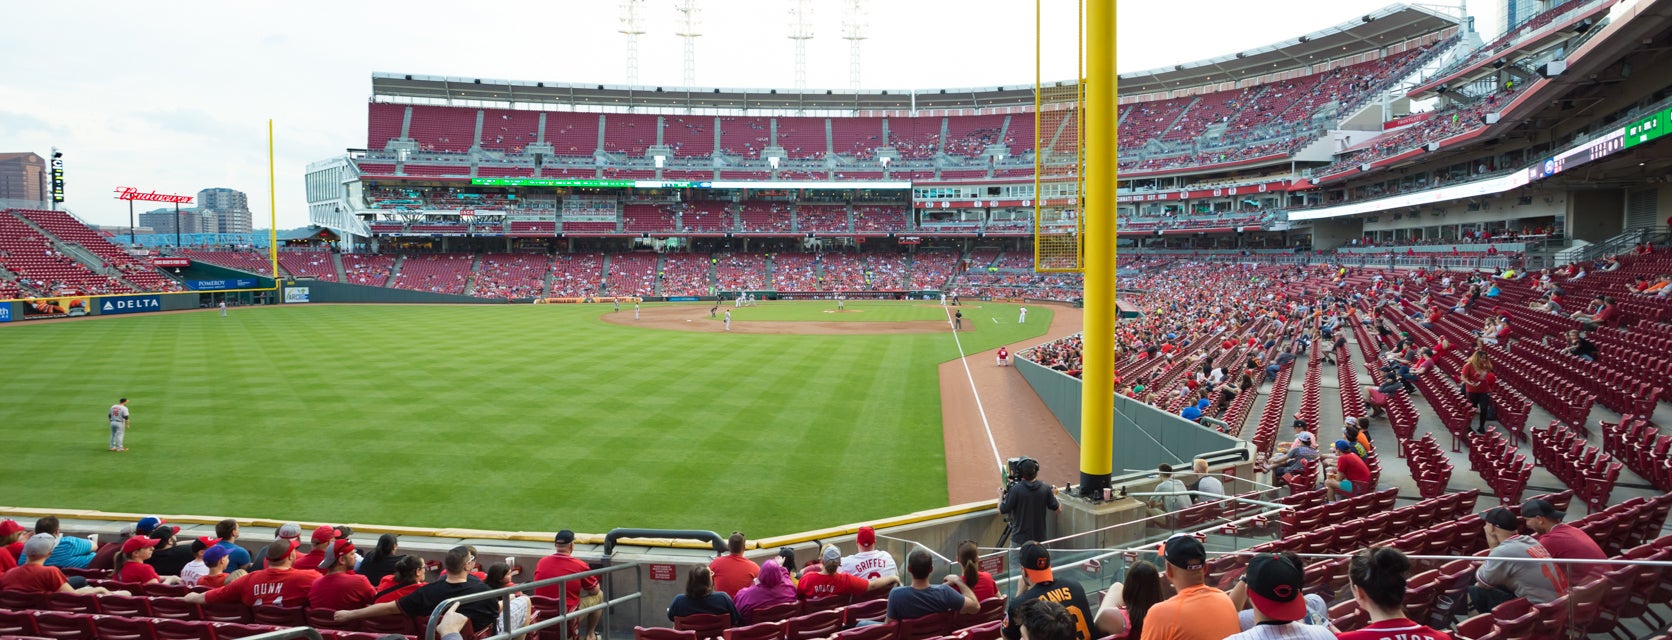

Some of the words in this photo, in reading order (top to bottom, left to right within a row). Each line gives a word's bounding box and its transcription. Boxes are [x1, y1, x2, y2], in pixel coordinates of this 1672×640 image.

[116, 186, 192, 203] Budweiser
[117, 299, 159, 309] DELTA
[855, 558, 886, 573] GRIFFEY
[253, 582, 284, 596] DUNN
